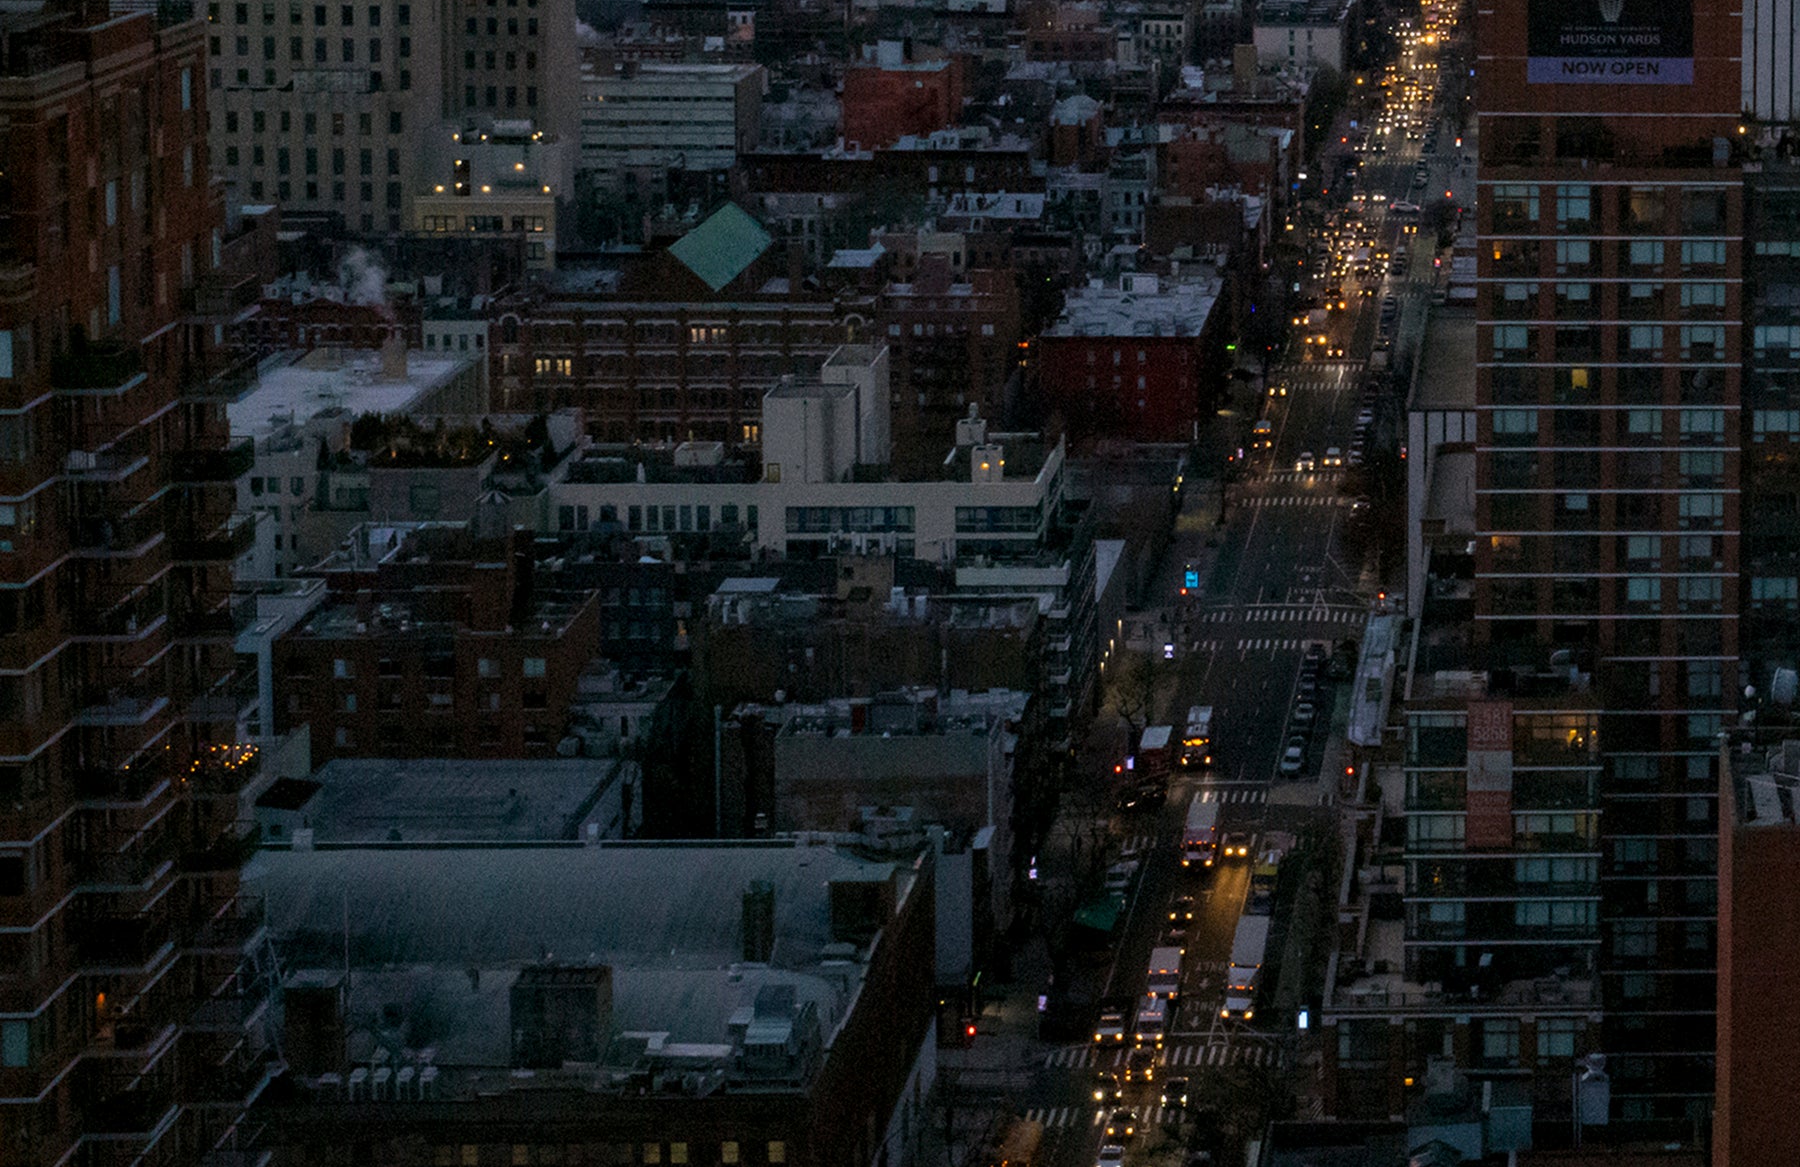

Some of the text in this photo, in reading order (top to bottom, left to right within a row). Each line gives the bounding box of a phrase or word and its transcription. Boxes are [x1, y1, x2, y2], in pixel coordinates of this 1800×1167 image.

[1560, 34, 1661, 45] HUDSON YARDS
[1562, 61, 1659, 75] NOW OPEN
